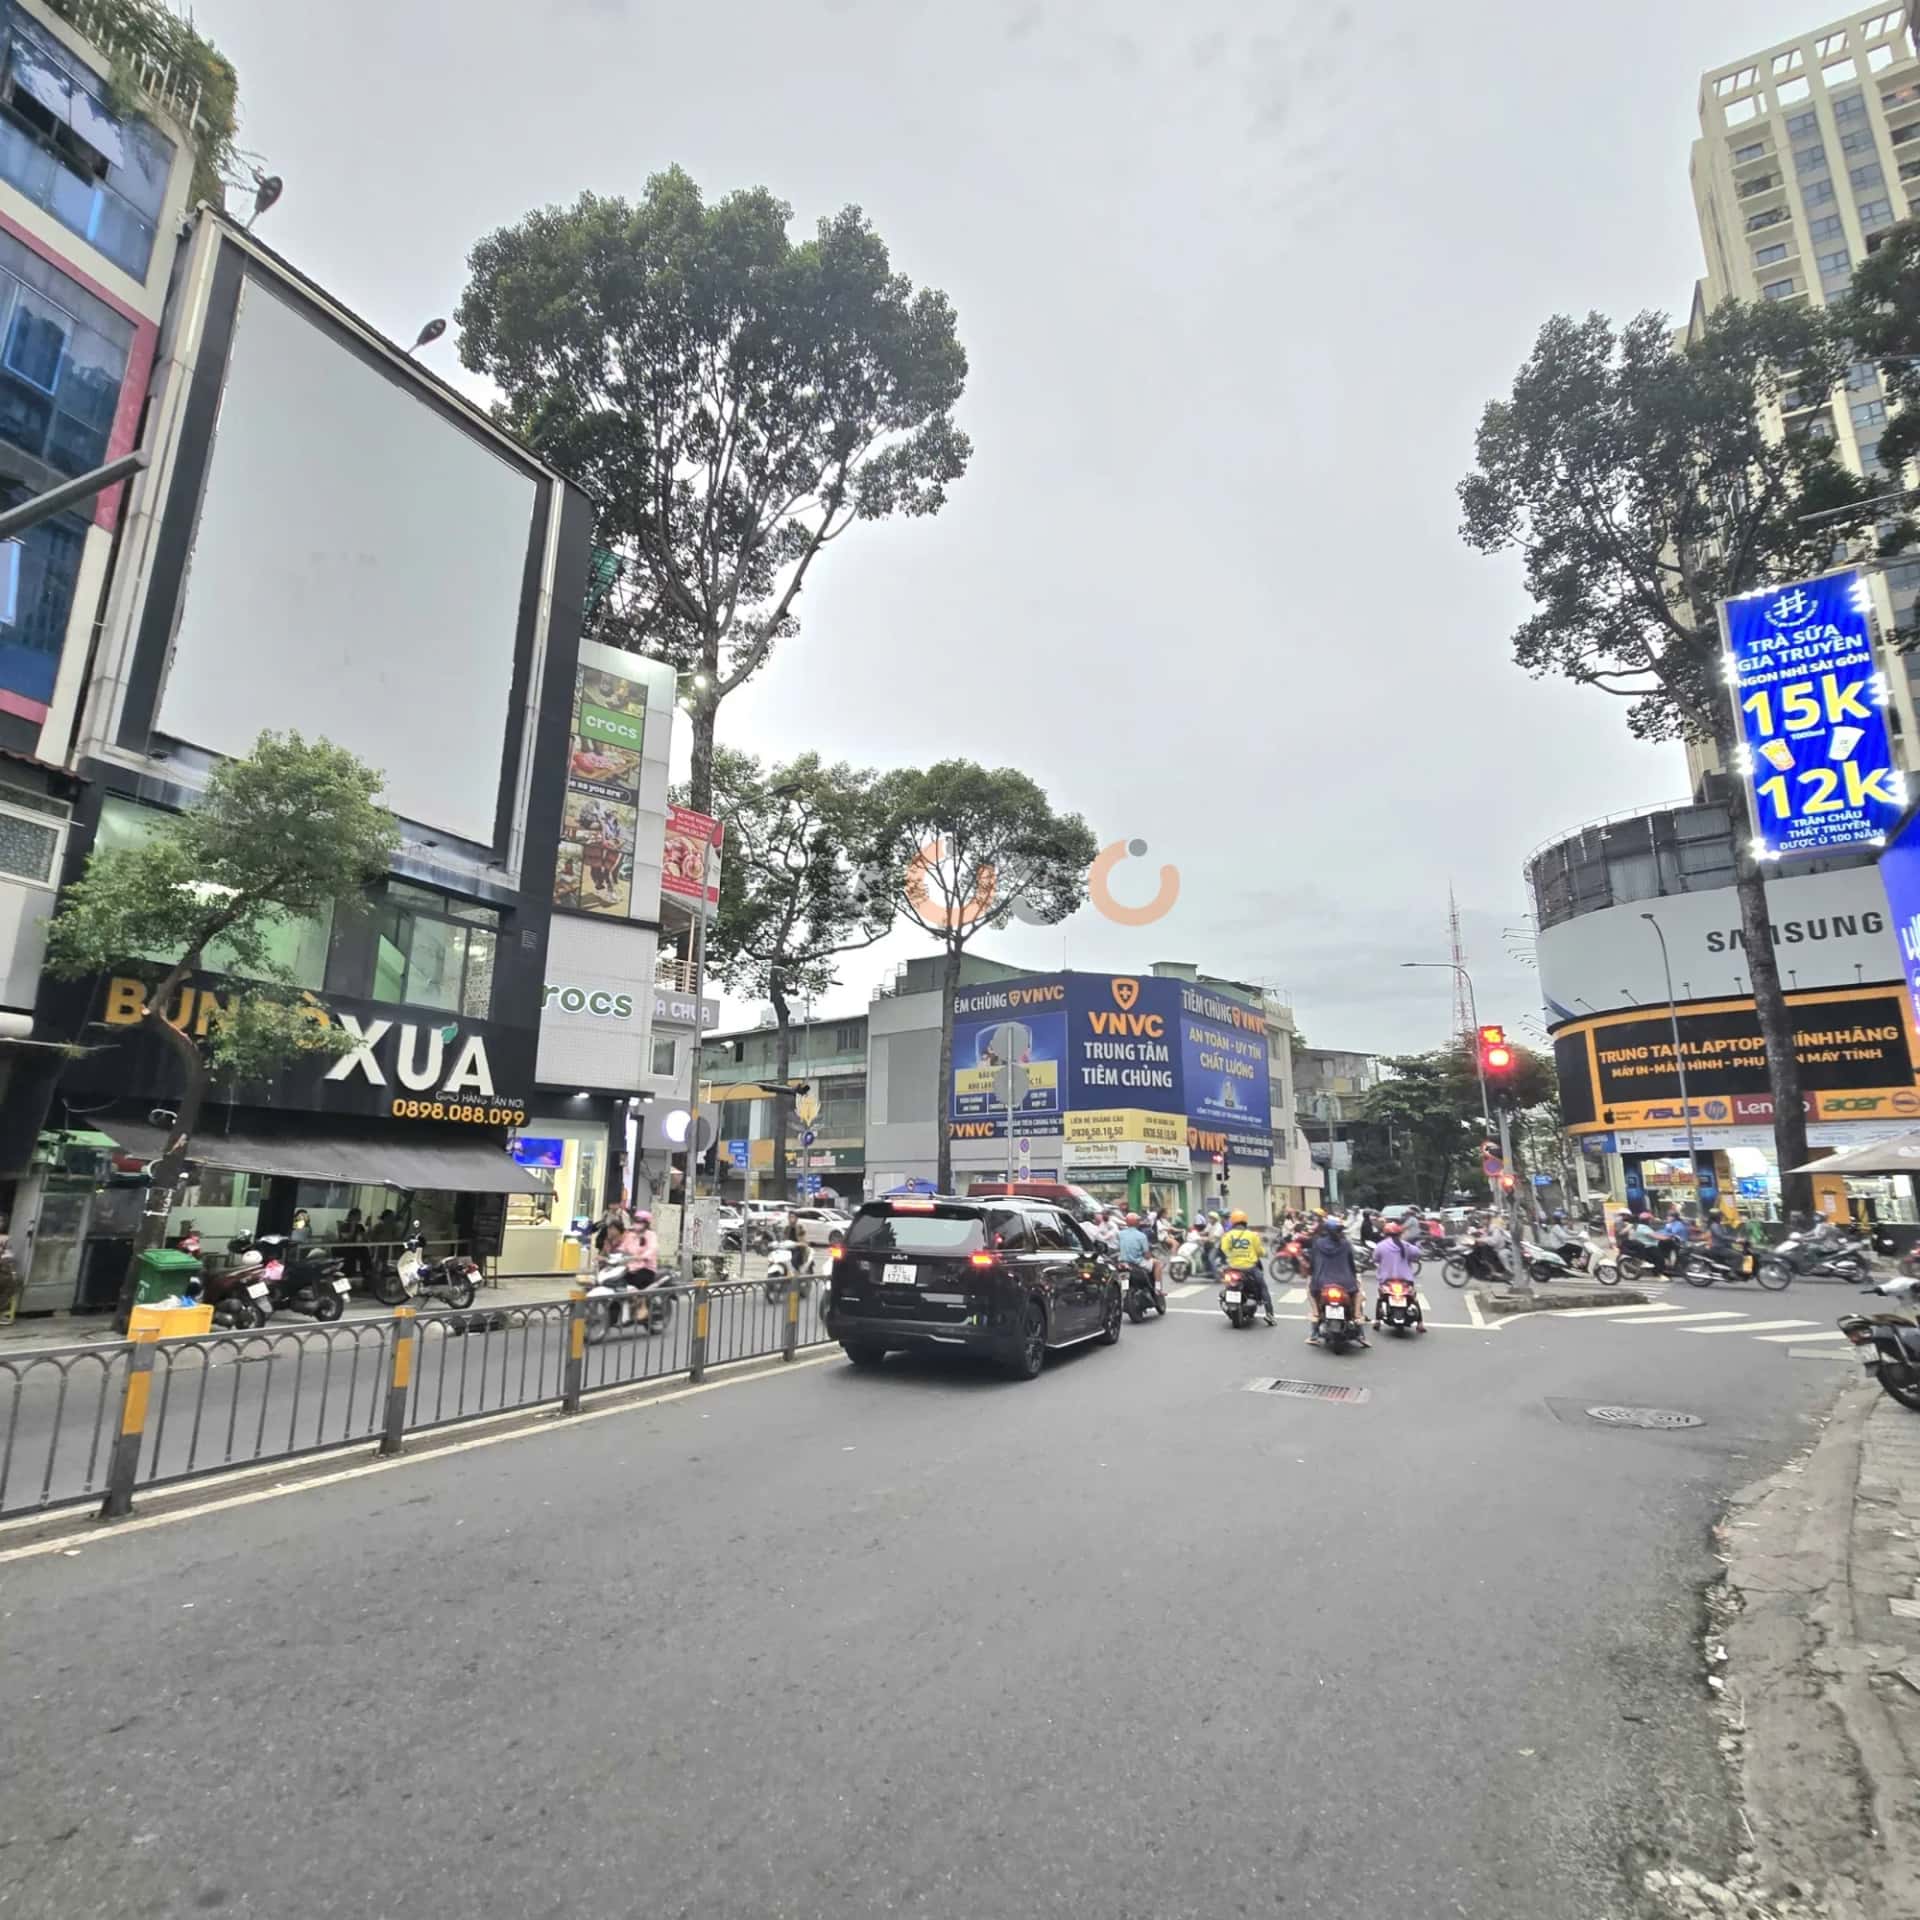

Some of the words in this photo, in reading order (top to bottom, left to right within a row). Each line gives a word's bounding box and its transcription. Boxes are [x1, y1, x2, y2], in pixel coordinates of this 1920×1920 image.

[1748, 632, 1790, 653] TRÀ
[1792, 623, 1840, 644] SỮA
[1737, 654, 1775, 672] GIA
[1777, 634, 1863, 663] TRUYỀN
[585, 715, 638, 740] crocs
[1830, 833, 1851, 843] 100
[541, 984, 633, 1019] rocs
[954, 991, 969, 1014] ÊM
[970, 991, 1007, 1012] CHỦNG
[1022, 985, 1065, 1004] VNVC
[1182, 988, 1205, 1014] TIÊM
[1204, 996, 1233, 1025] CHỦNG
[1240, 1008, 1266, 1035] VNVC
[1088, 1011, 1164, 1038] VNVC
[1189, 1027, 1204, 1044] AN
[1204, 1029, 1230, 1050] TOÀN
[1599, 1047, 1648, 1064] TRUNG
[1691, 1037, 1765, 1055] LAPTOP
[1792, 1029, 1834, 1048] ÍNH
[1834, 1025, 1899, 1044] HÃNG
[1084, 1041, 1136, 1061] TRUNG
[1137, 1041, 1169, 1062] TÂM
[1687, 1058, 1723, 1072] HÌNH
[1807, 1049, 1841, 1064] MÁY
[1841, 1047, 1884, 1062] TÍNH
[1081, 1063, 1119, 1085] TIÊM
[1121, 1065, 1173, 1088] CHỦNG
[1200, 1051, 1224, 1072] CHẤT
[1225, 1056, 1255, 1081] LƯỢNG
[392, 1098, 525, 1126] 0898.088.099
[1644, 1105, 1700, 1121] ASUS
[1737, 1100, 1810, 1116] Leno
[1823, 1096, 1888, 1113] acer
[955, 1121, 995, 1138] VNVC
[1198, 1130, 1228, 1153] VNVC
